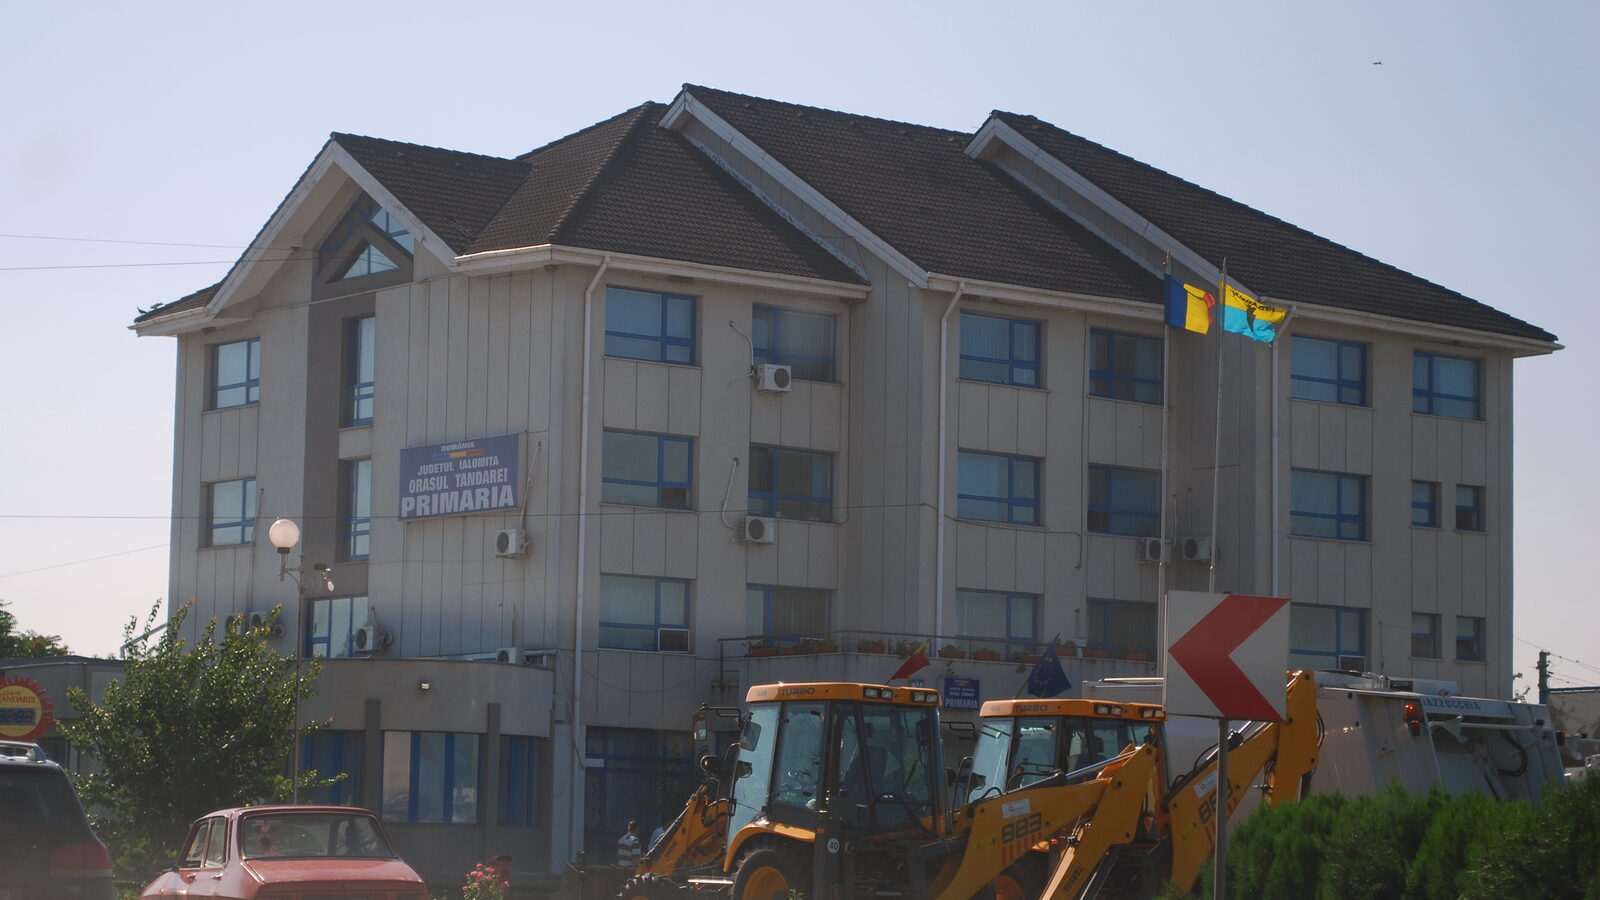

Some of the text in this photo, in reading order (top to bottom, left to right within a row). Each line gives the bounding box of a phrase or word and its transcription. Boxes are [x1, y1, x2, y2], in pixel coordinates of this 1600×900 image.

[417, 456, 499, 475] JUDETUL IALOMITA
[408, 468, 507, 494] ORASUL TANDAREI
[401, 485, 514, 517] PRIMARIA
[780, 687, 816, 697] TURBO
[0, 696, 35, 704] ANDAREI
[945, 698, 978, 709] PRIMARIA
[1015, 704, 1048, 713] TURBO
[829, 841, 839, 850] 40
